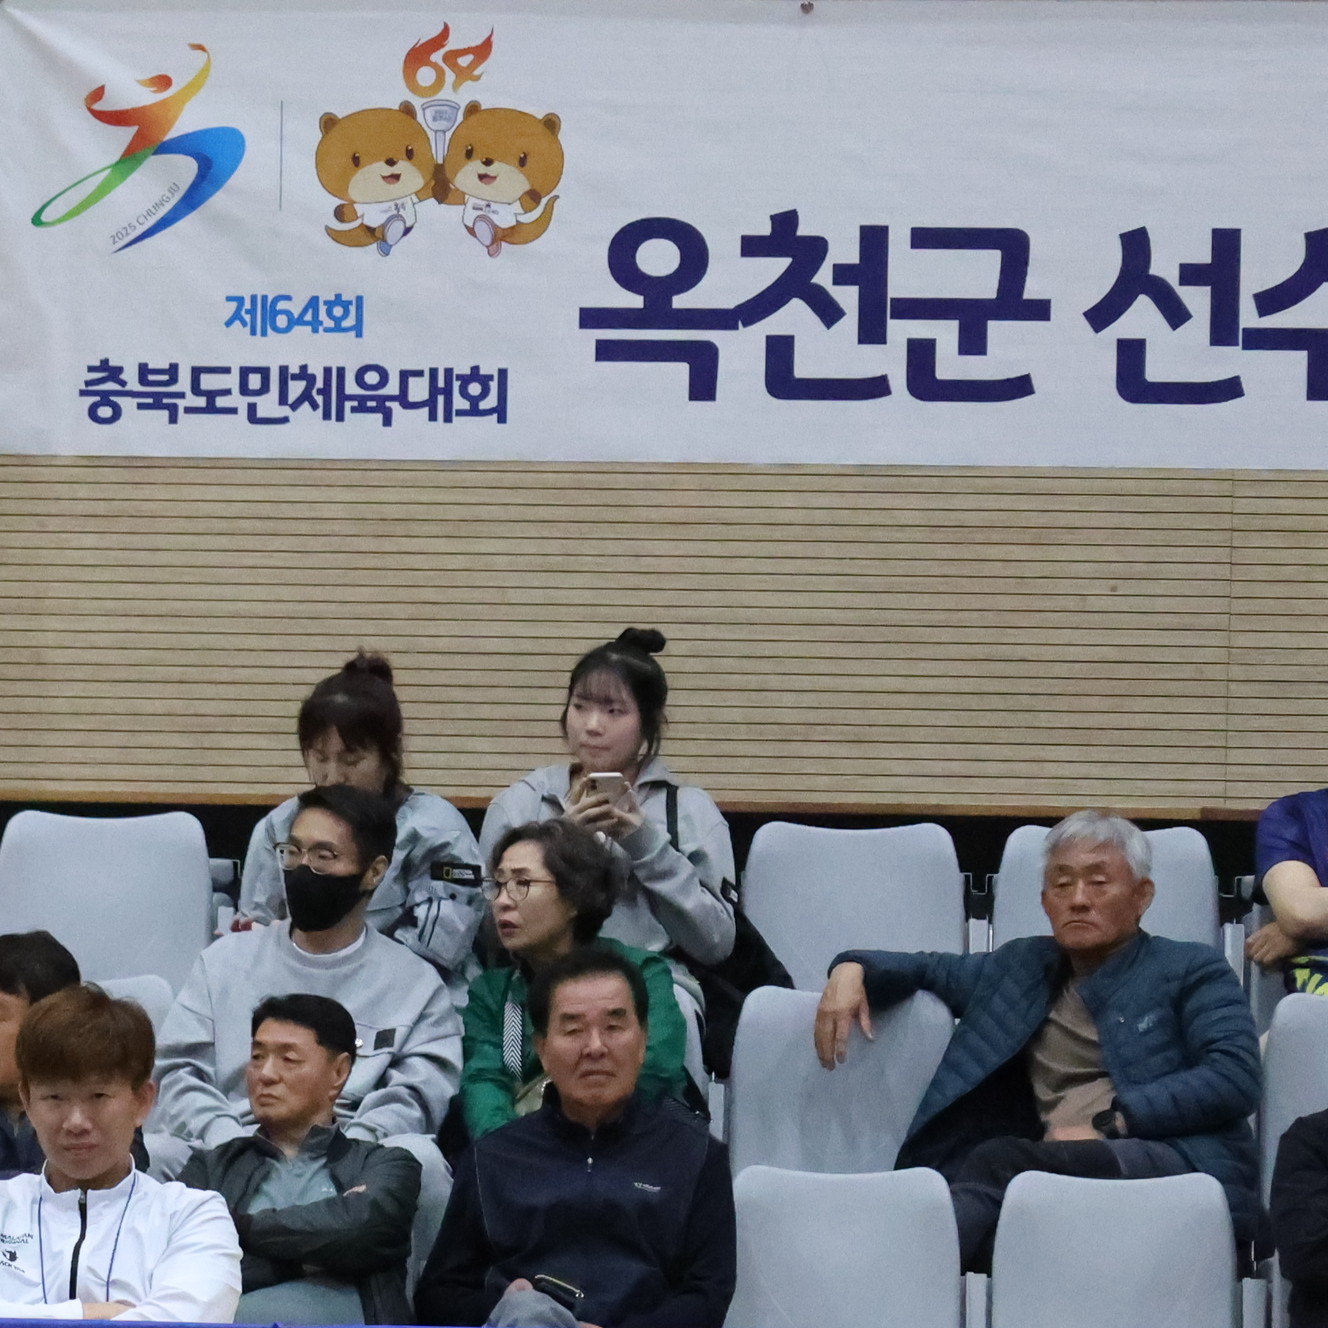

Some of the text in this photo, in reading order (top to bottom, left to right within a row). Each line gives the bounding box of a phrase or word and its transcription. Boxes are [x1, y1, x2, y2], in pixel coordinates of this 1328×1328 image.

[403, 21, 494, 98] 64
[109, 181, 181, 246] 2025 CHUNGJU
[224, 294, 364, 338] 제64회
[579, 208, 1051, 403] 옥천군
[79, 358, 508, 427] 충북도민체육대회
